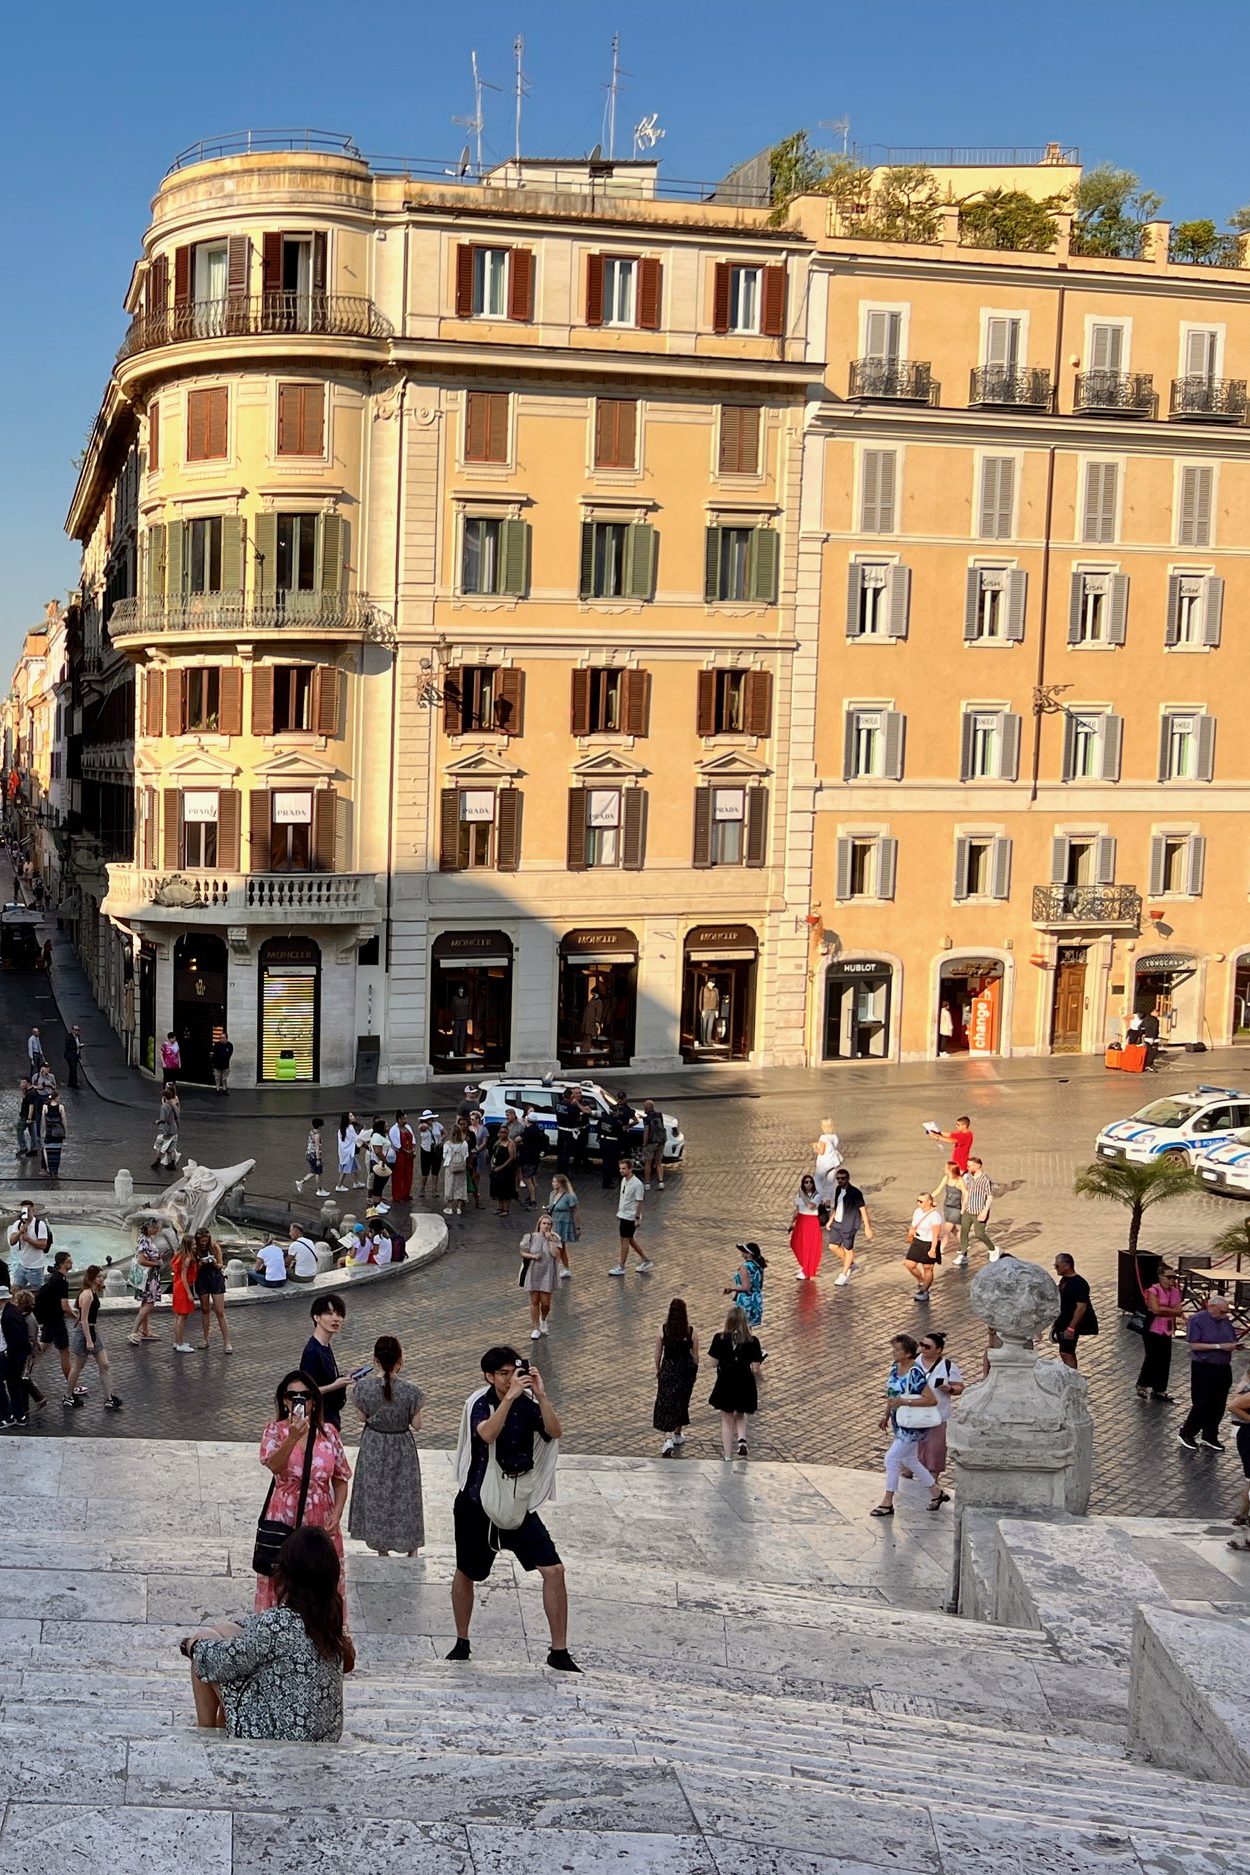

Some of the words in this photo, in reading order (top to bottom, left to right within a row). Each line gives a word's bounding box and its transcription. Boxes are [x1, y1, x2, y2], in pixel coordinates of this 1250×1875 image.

[277, 809, 307, 817] PRADA
[713, 806, 739, 814] PRADA
[267, 950, 312, 960] MONCLER
[843, 963, 876, 972] HUBLOT
[974, 1002, 990, 1049] change
